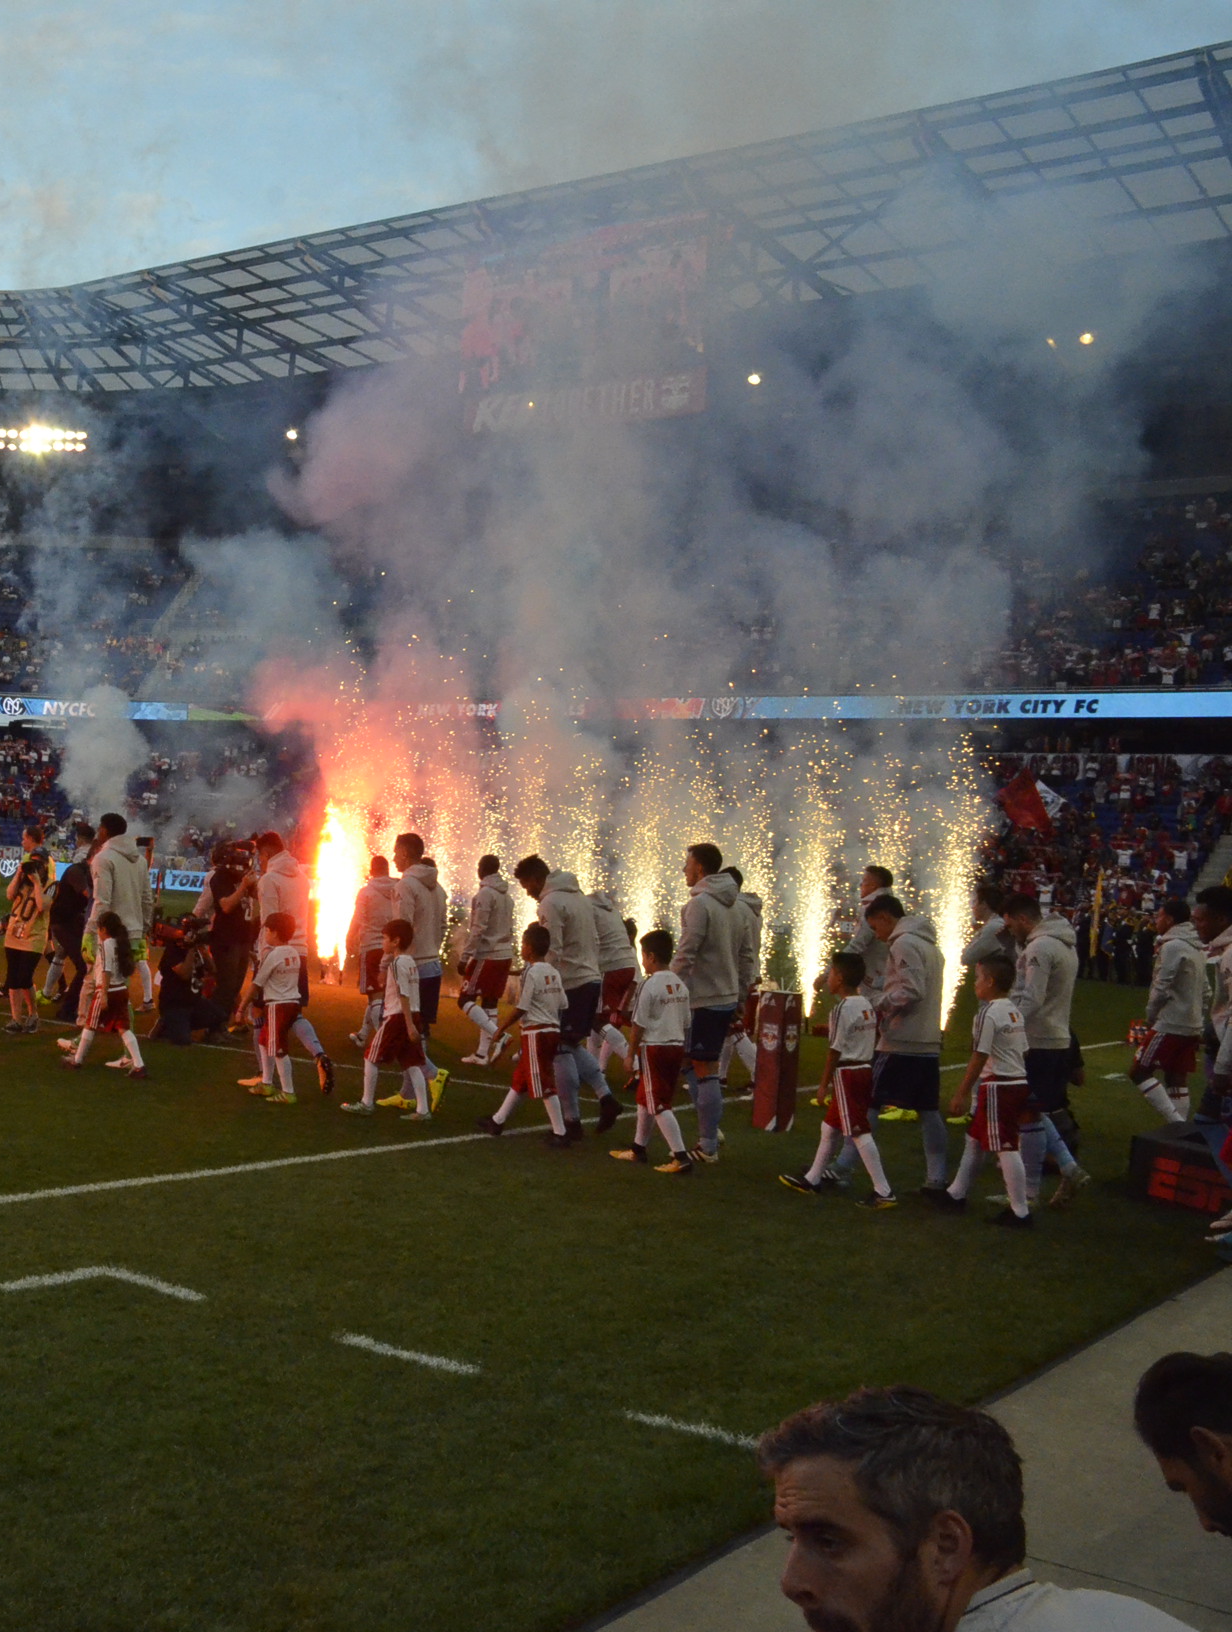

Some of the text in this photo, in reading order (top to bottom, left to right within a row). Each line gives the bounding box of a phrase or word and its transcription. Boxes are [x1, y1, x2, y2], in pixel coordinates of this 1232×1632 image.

[42, 701, 96, 717] NYCFC
[457, 703, 499, 717] YORK
[954, 699, 1011, 714] YORK
[1020, 699, 1067, 714] CITY
[1074, 699, 1100, 714] FC
